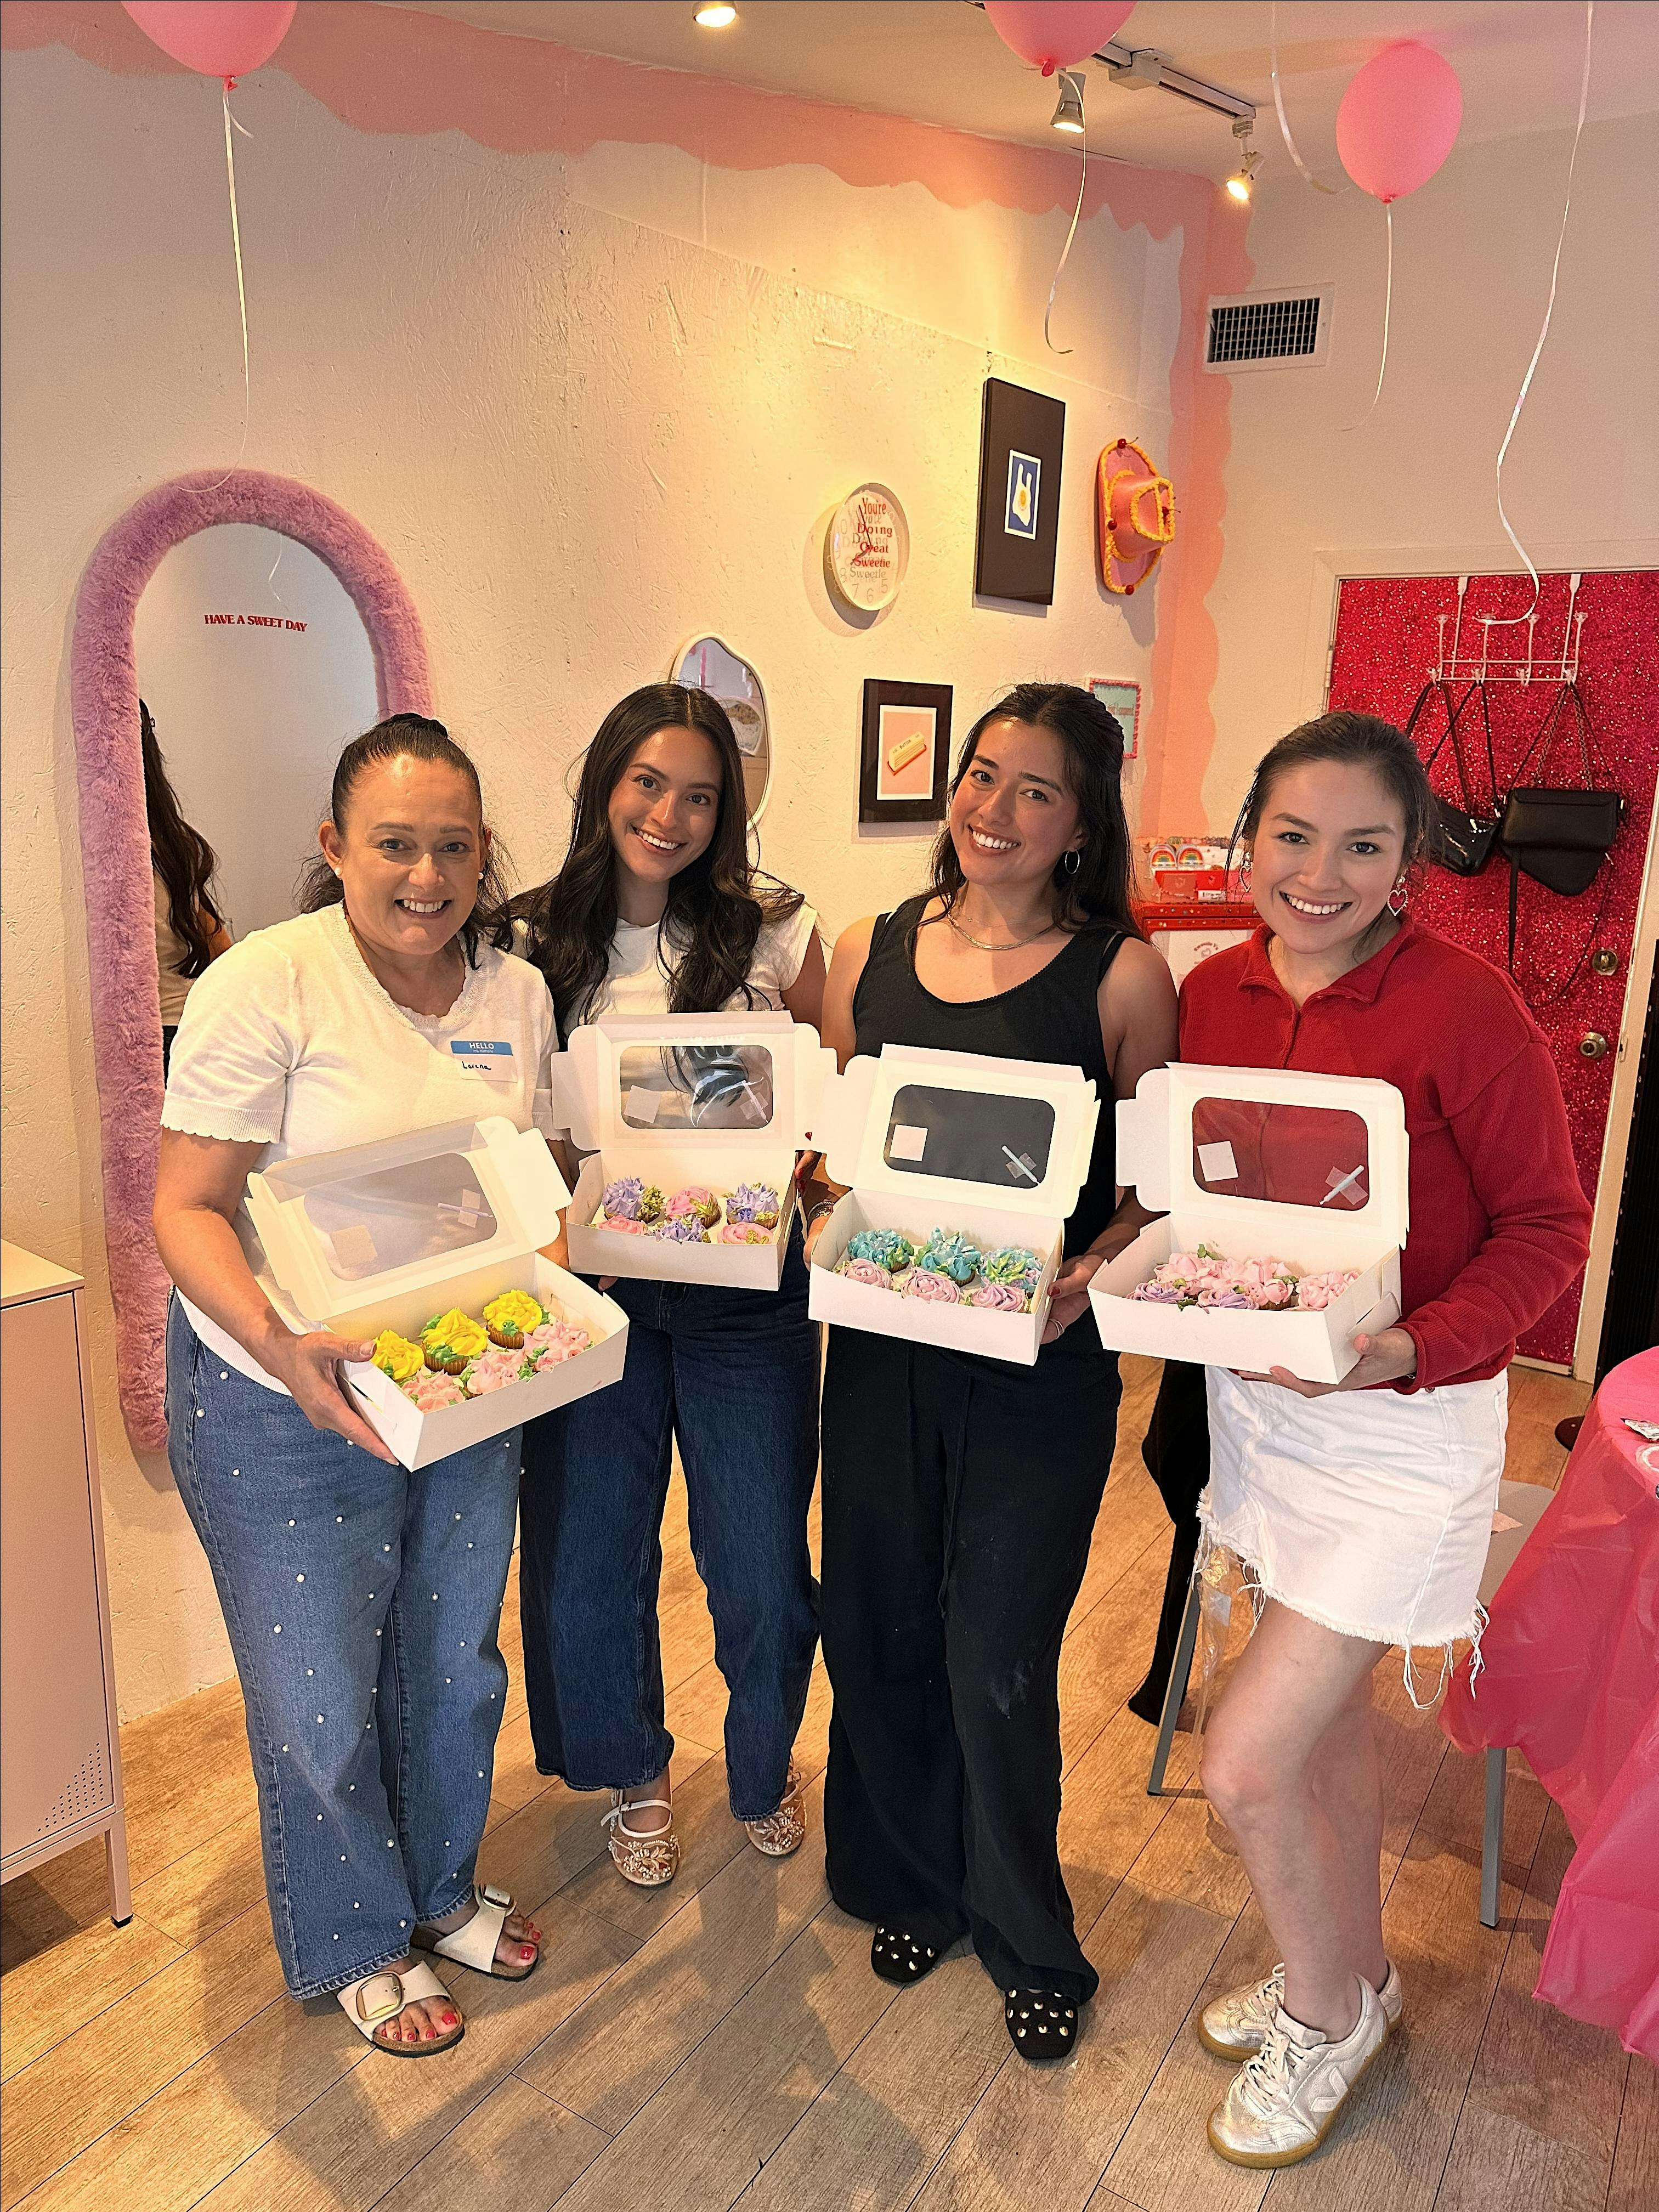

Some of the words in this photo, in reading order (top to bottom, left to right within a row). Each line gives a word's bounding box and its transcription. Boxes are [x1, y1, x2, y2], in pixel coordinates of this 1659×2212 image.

[857, 523, 893, 538] Doing
[204, 614, 235, 624] HAVE
[236, 615, 246, 624] A
[247, 615, 284, 628] SWEET
[285, 620, 308, 632] DAY
